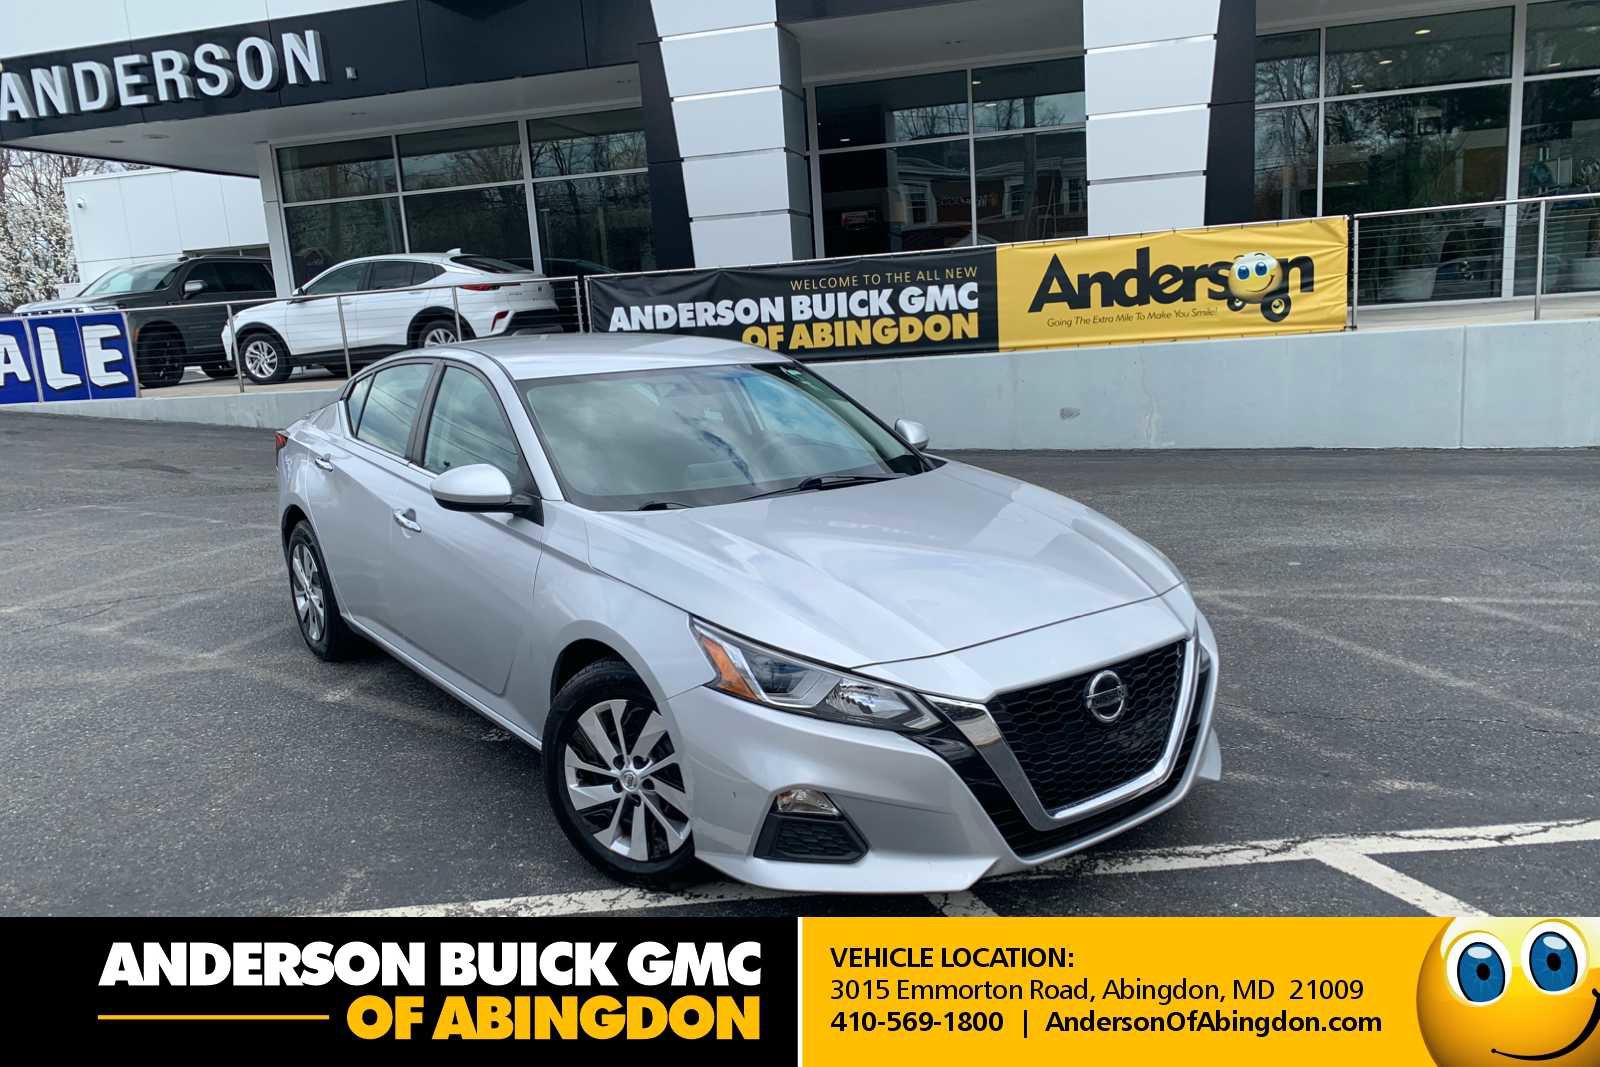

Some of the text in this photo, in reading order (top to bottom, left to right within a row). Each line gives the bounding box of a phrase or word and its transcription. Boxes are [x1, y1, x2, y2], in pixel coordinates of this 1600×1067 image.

[0, 30, 325, 120] ANDERSON
[790, 266, 978, 291] WELCOME TO THE ALL NEW
[608, 281, 979, 333] ANDERSON BUICK GMC
[1047, 317, 1073, 328] Going
[1074, 315, 1091, 325] The
[1092, 314, 1114, 324] Extra
[1115, 312, 1134, 322] Mile
[1136, 311, 1145, 321] To
[1147, 309, 1172, 320] Make
[1174, 309, 1190, 319] You
[742, 312, 979, 351] OF ABINGDON
[0, 324, 129, 390] ALE
